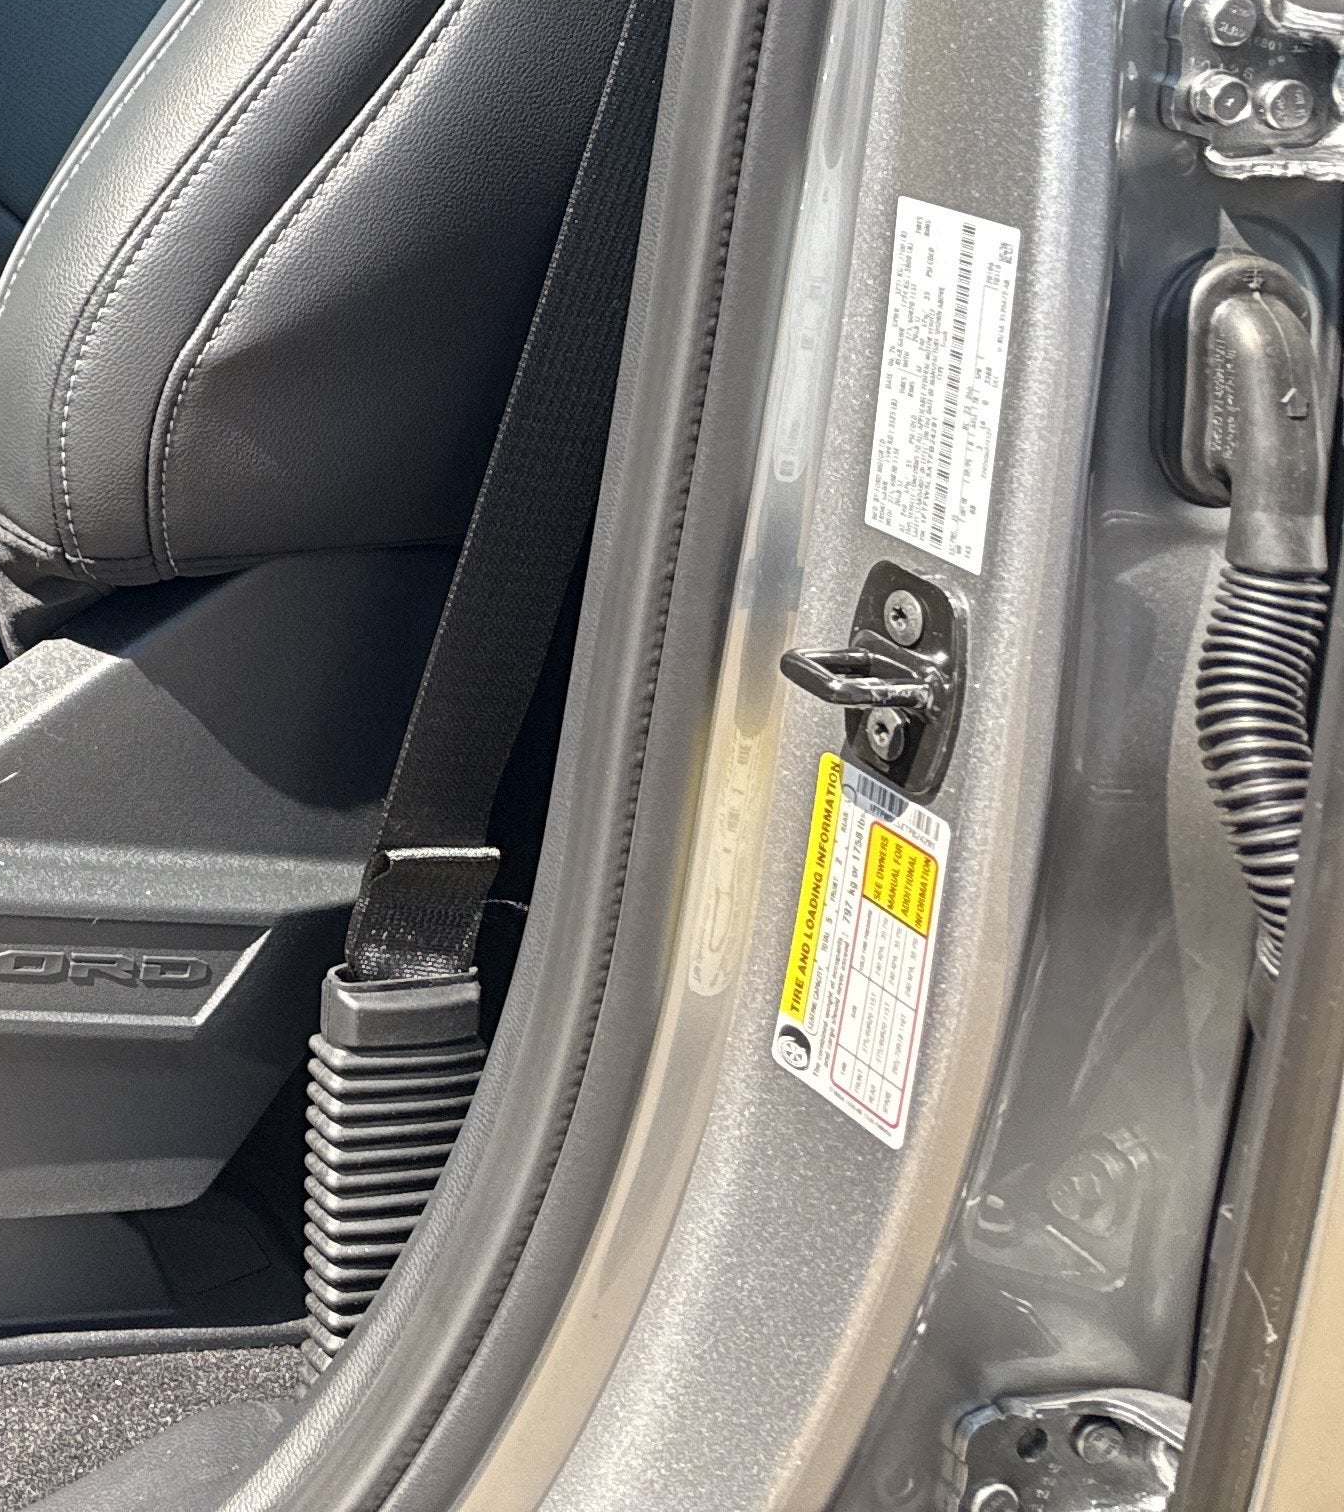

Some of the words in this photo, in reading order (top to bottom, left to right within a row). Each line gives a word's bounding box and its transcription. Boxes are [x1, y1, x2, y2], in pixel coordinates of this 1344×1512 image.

[816, 761, 841, 868] INFORMATION
[834, 856, 842, 865] 2
[851, 831, 863, 860] 1758
[892, 842, 903, 865] FOR
[851, 865, 858, 878] or
[900, 856, 916, 916] ADDITIONAL
[846, 880, 858, 896] kg
[873, 880, 883, 900] SEE
[887, 868, 900, 910] MANUAL
[914, 856, 930, 928] INFORMATION
[804, 872, 823, 940] LOADING
[842, 899, 852, 924] 797
[798, 943, 811, 976] AND
[790, 977, 804, 1012] TIRE
